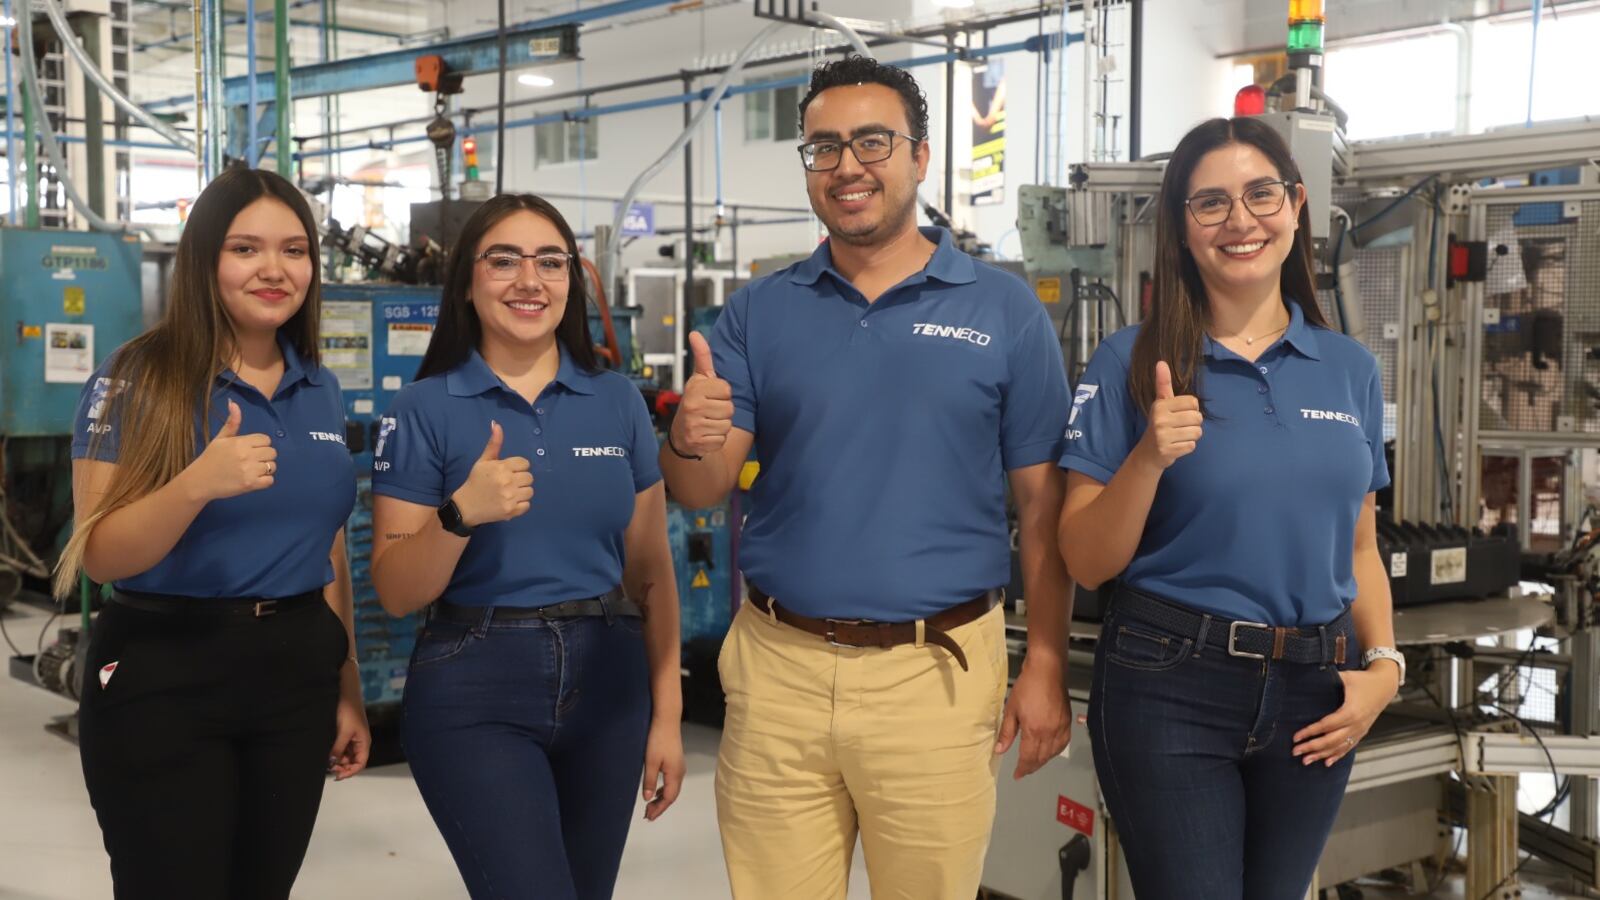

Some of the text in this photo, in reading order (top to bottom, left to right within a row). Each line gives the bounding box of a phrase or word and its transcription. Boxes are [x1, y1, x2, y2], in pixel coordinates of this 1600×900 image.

[385, 306, 410, 319] SGS
[912, 323, 991, 346] TENNECO
[1300, 409, 1359, 427] TENNECO
[86, 422, 112, 435] AVP
[572, 446, 625, 457] TENNECO
